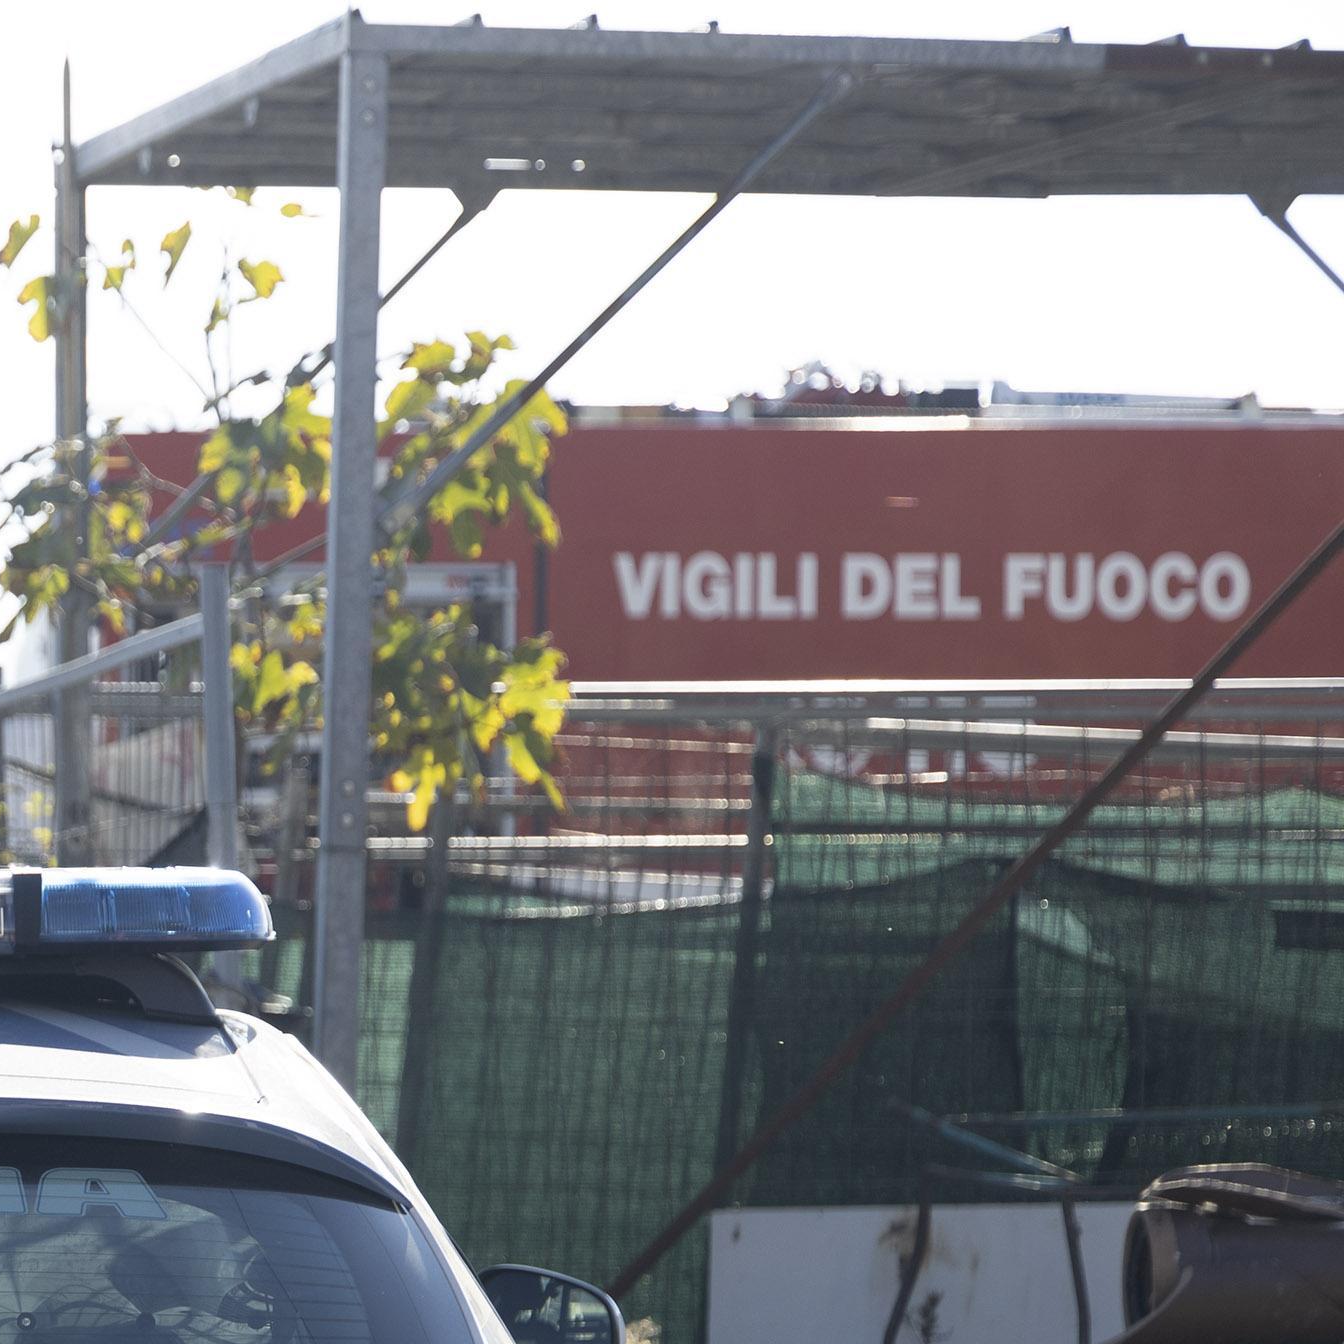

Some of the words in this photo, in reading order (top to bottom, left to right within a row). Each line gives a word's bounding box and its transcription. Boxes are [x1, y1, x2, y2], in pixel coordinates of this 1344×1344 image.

[614, 551, 818, 620] VIGILI
[841, 553, 982, 620] DEL
[1004, 552, 1252, 622] FUOCO
